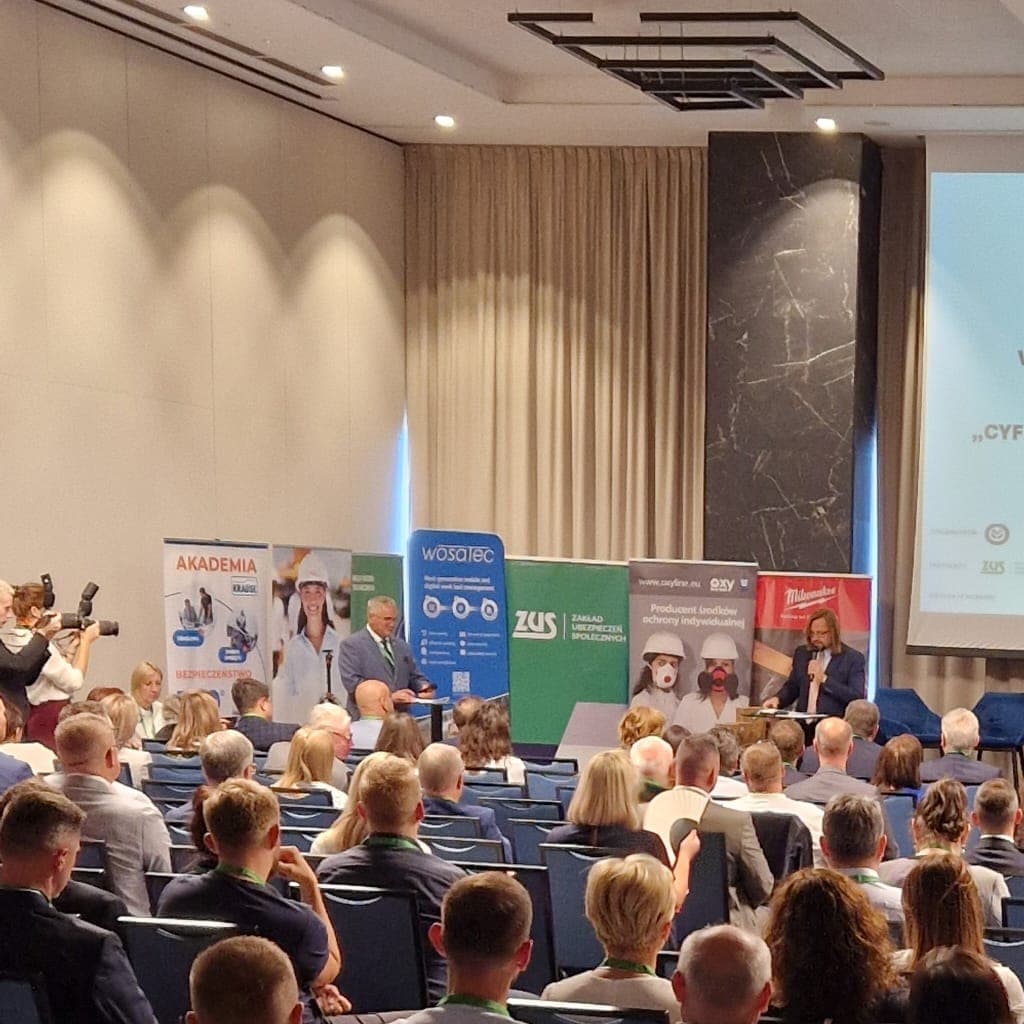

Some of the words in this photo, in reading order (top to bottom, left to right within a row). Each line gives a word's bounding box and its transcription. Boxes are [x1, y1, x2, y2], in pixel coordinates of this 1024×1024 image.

[176, 555, 257, 573] AKADEMIA
[650, 604, 697, 613] Producent
[700, 604, 737, 616] środków
[511, 610, 558, 640] ZUS
[571, 614, 604, 623] ZAKŁAD
[642, 614, 679, 627] ochrony
[680, 615, 745, 630] indywidualnej
